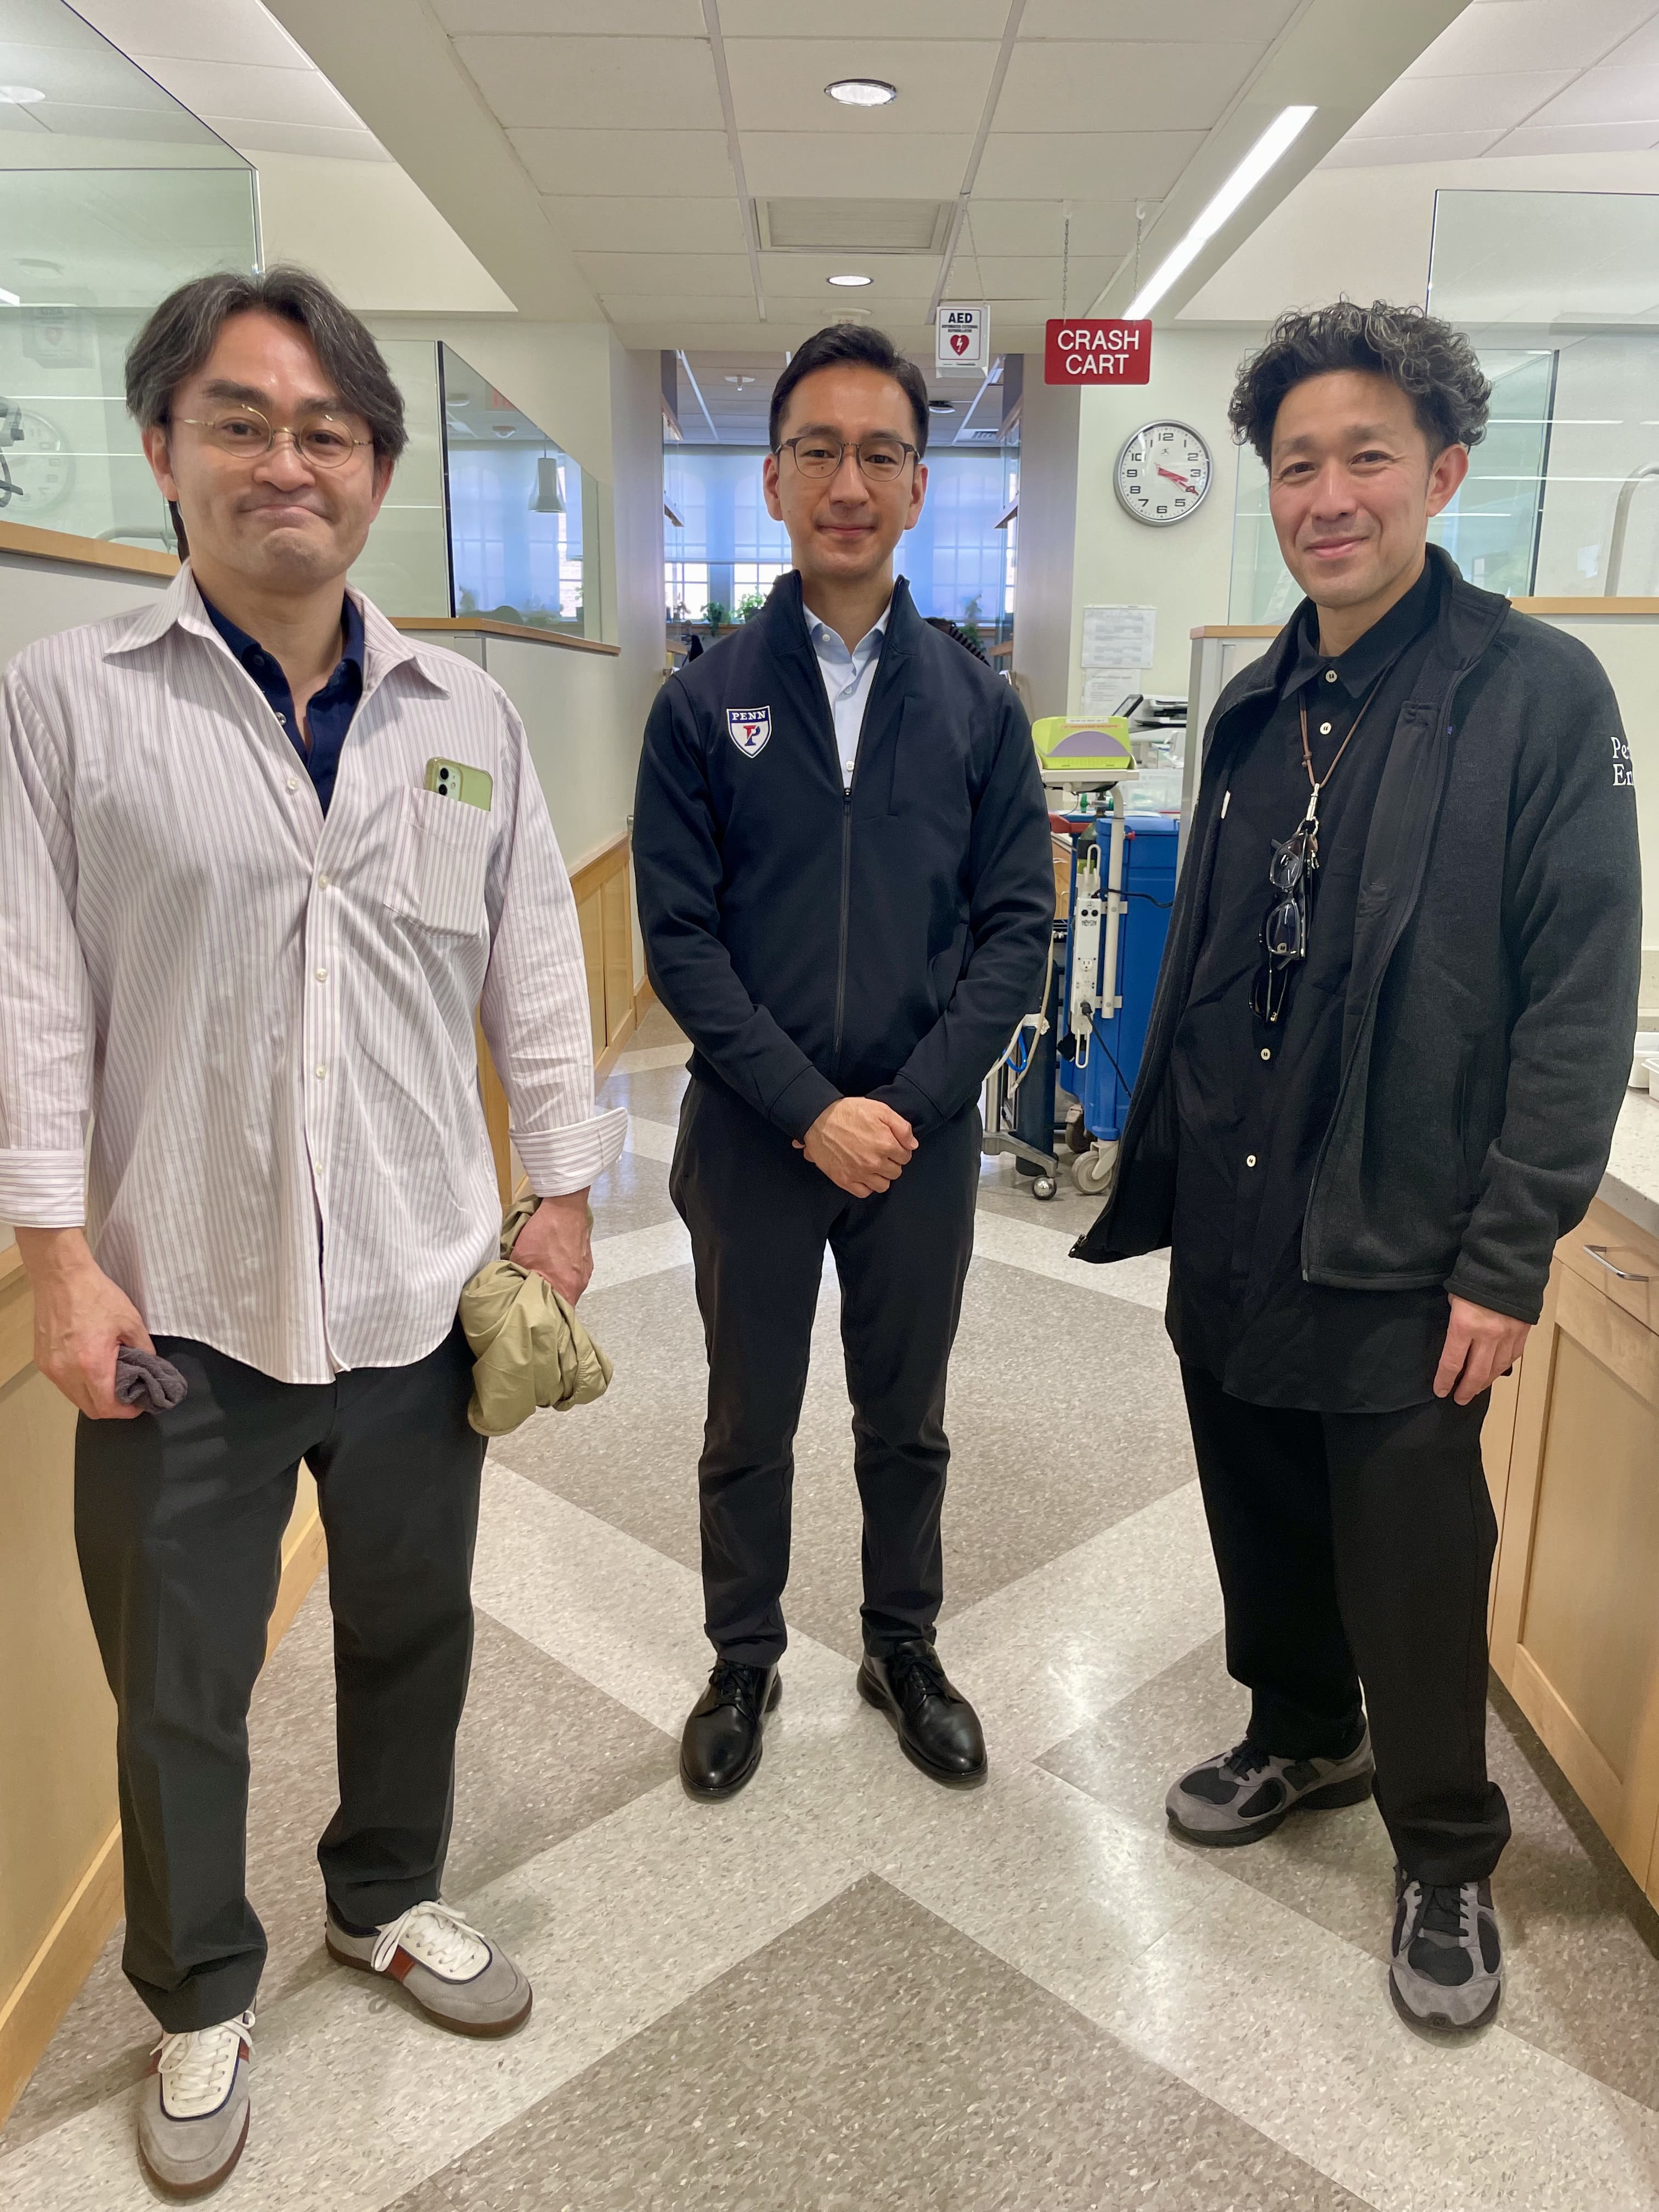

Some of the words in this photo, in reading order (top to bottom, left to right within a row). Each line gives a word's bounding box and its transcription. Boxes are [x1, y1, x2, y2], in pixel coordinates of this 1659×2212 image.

[948, 313, 973, 323] AED
[1057, 330, 1139, 350] CRASH
[1065, 354, 1129, 374] CART
[1159, 433, 1173, 441] 12
[1184, 439, 1187, 448] 1
[1190, 469, 1201, 477] 3
[732, 710, 766, 720] PENN
[743, 725, 760, 746] P
[1610, 736, 1629, 759] Pe
